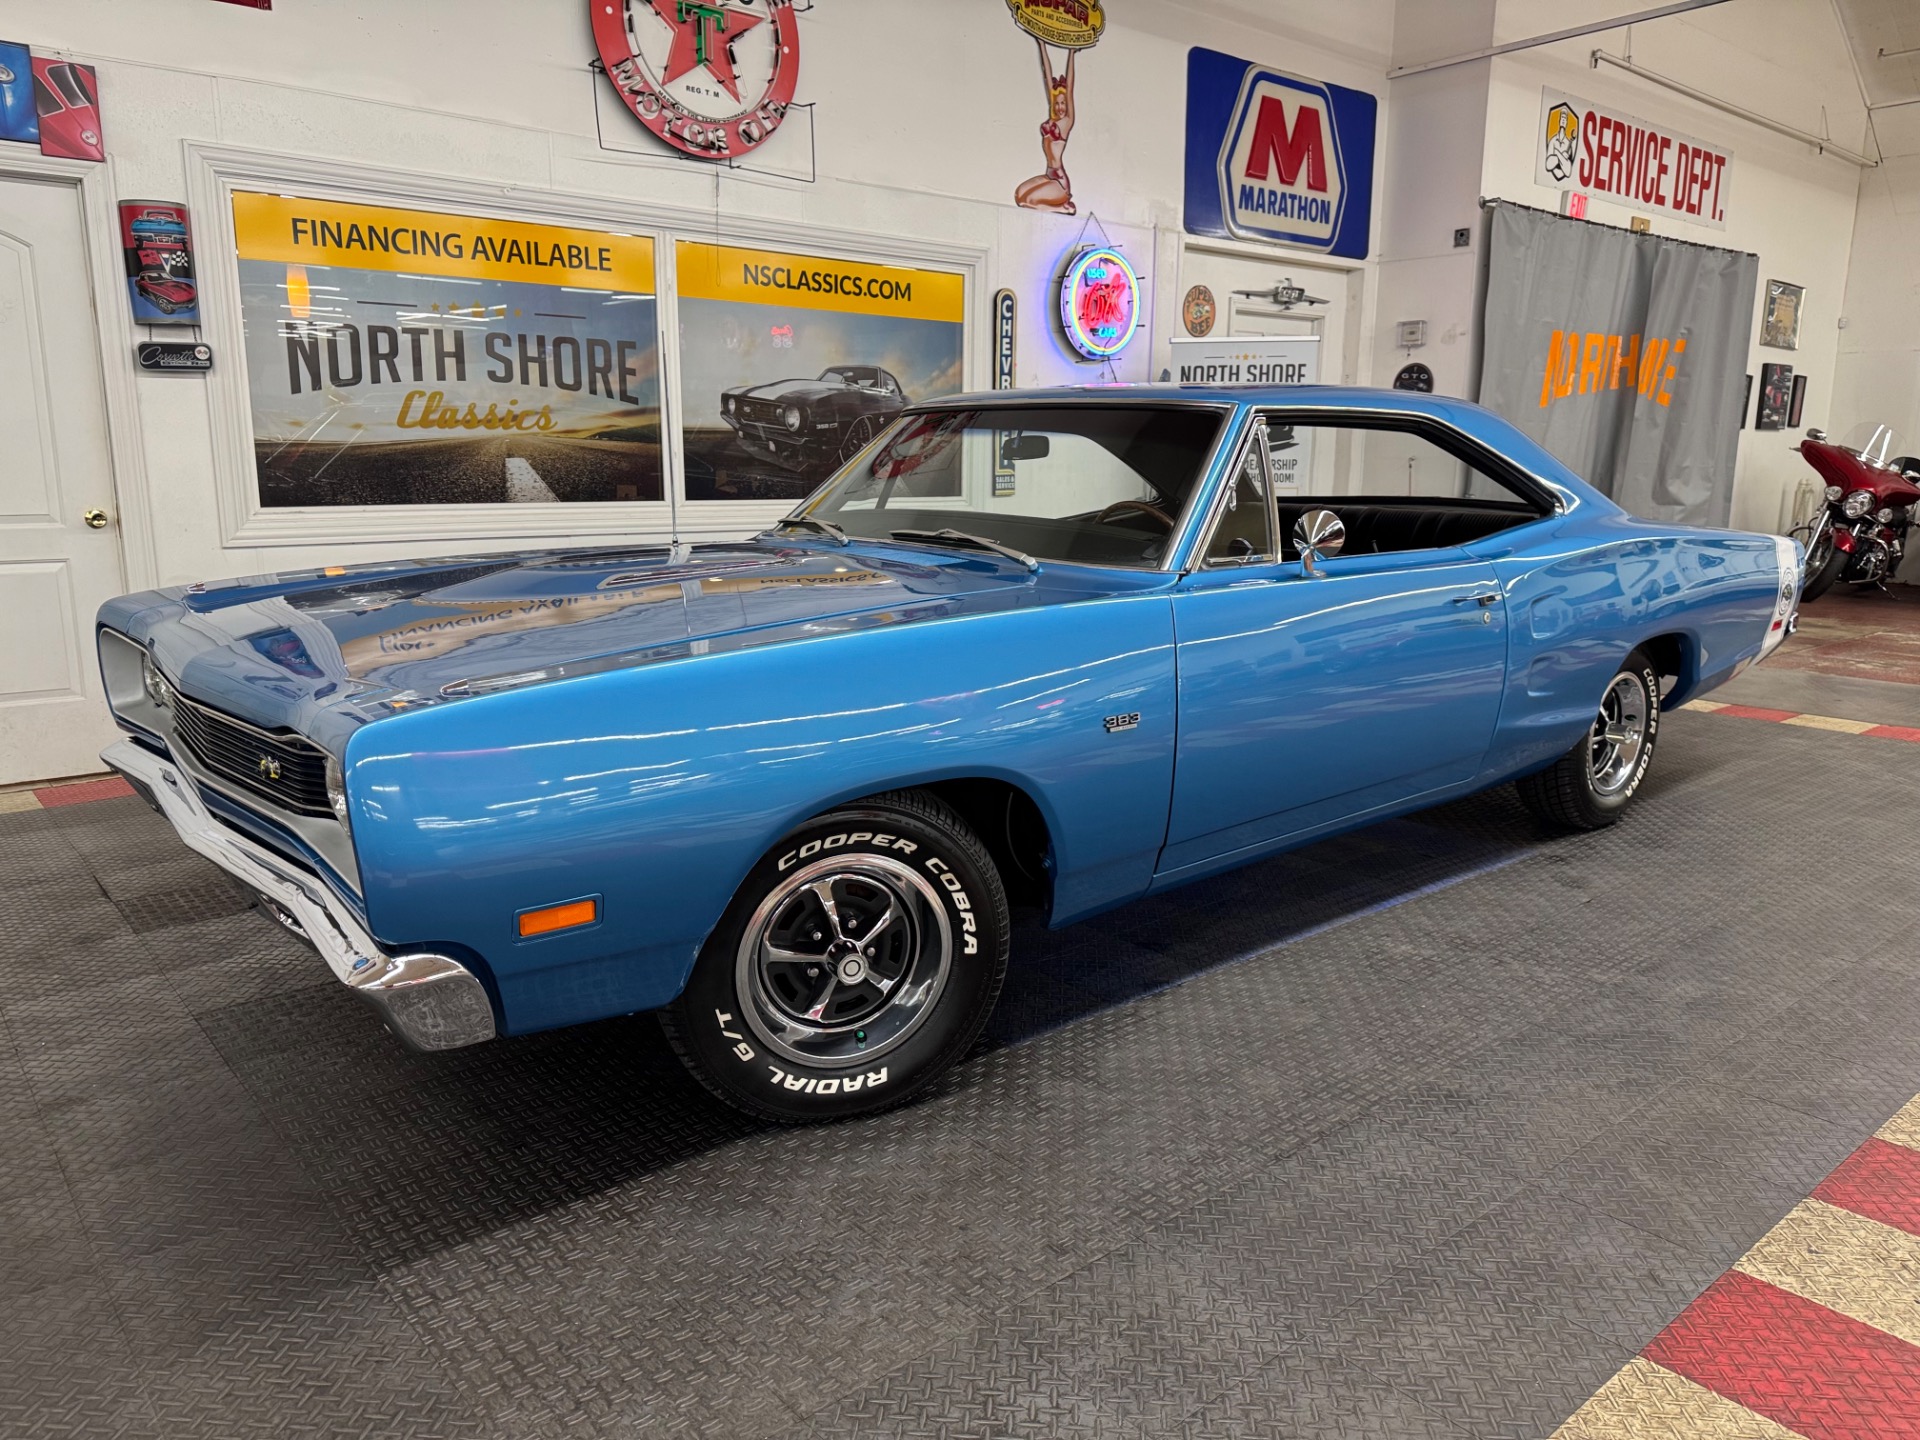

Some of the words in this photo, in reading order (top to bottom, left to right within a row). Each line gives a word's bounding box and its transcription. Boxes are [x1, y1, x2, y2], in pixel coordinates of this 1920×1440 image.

[1031, 8, 1044, 18] PARTS
[1046, 13, 1054, 21] AND
[1056, 15, 1083, 29] ACCESSORIES
[611, 57, 730, 155] MOTOR
[1245, 95, 1327, 193] M
[1579, 110, 1672, 207] SERVICE
[1672, 142, 1726, 222] DEPT.
[1238, 184, 1331, 225] MARATHON
[1569, 192, 1588, 219] EXIT
[291, 218, 464, 259] FINANCING
[471, 236, 612, 272] AVAILABLE
[743, 263, 912, 302] NSCLASSICS.COM
[1086, 268, 1107, 278] USED
[1190, 317, 1211, 335] BEE
[140, 346, 197, 365] Corvette
[284, 320, 467, 395] NORTH
[485, 331, 640, 406] SHORE
[1180, 364, 1240, 383] NORTH
[1401, 372, 1428, 380] GTO
[396, 390, 558, 431] Classics
[1643, 668, 1658, 734] COOPER
[1625, 742, 1652, 797] COBRA
[777, 832, 918, 872] COOPER
[925, 857, 978, 955] COBRA
[715, 1008, 756, 1062] G/T
[767, 1065, 889, 1095] RADIAL
